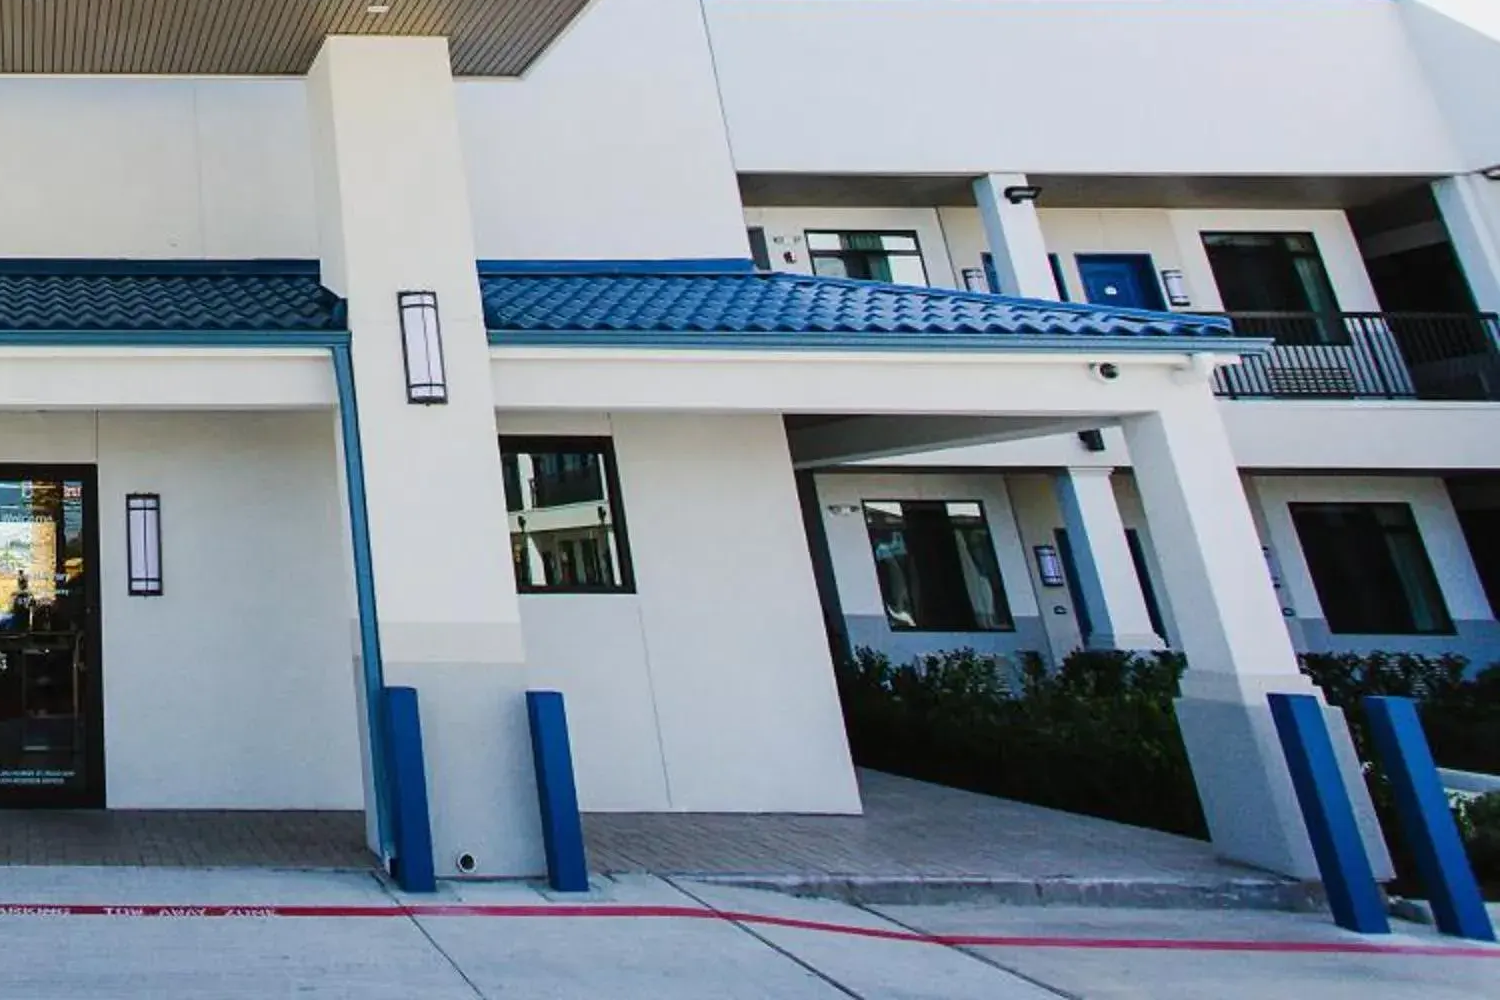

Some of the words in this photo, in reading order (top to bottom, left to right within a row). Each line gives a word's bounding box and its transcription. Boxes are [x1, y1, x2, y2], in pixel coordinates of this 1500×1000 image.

[102, 906, 144, 917] TOW
[158, 906, 207, 917] AWAY
[223, 906, 277, 917] ZONE
